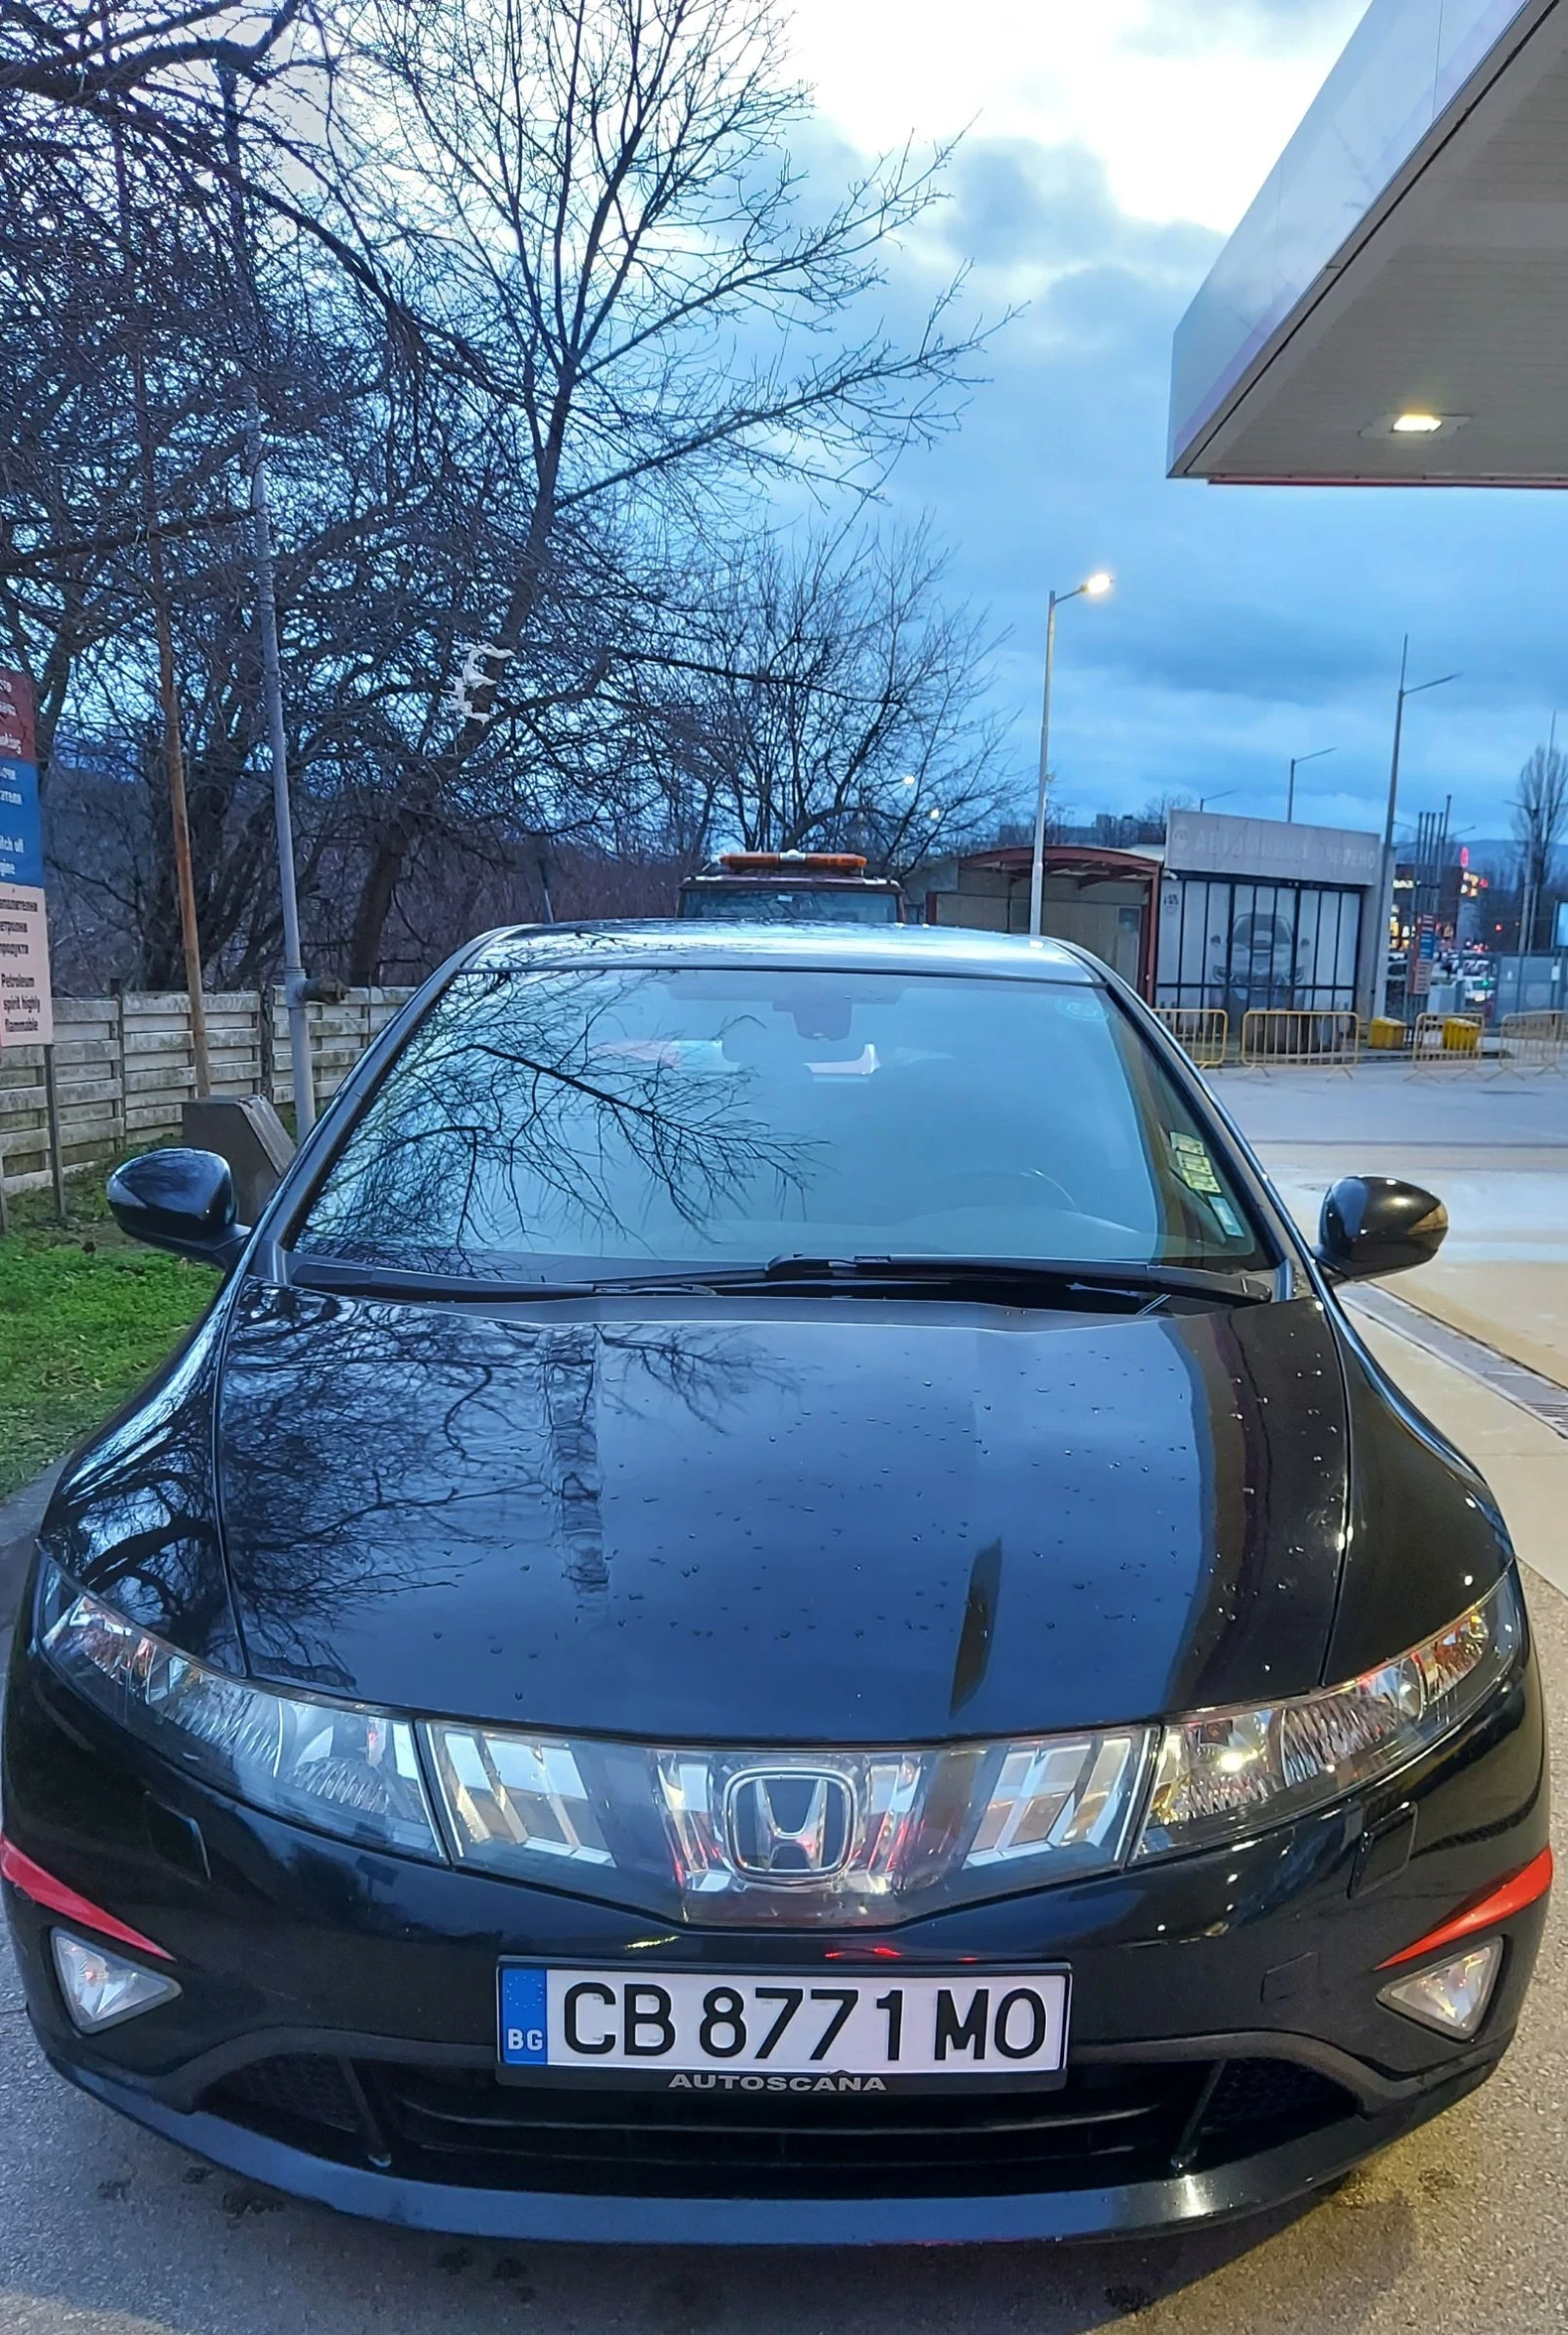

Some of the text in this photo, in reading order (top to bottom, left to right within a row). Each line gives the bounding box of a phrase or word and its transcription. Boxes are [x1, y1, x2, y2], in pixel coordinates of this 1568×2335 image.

[1, 972, 35, 988] Petroleum
[3, 994, 41, 1014] spirit highly
[5, 1018, 39, 1033] flammable
[563, 1981, 1048, 2062] CB 8771 MO
[507, 2028, 544, 2052] BG
[668, 2073, 887, 2092] AUTOSCANA
